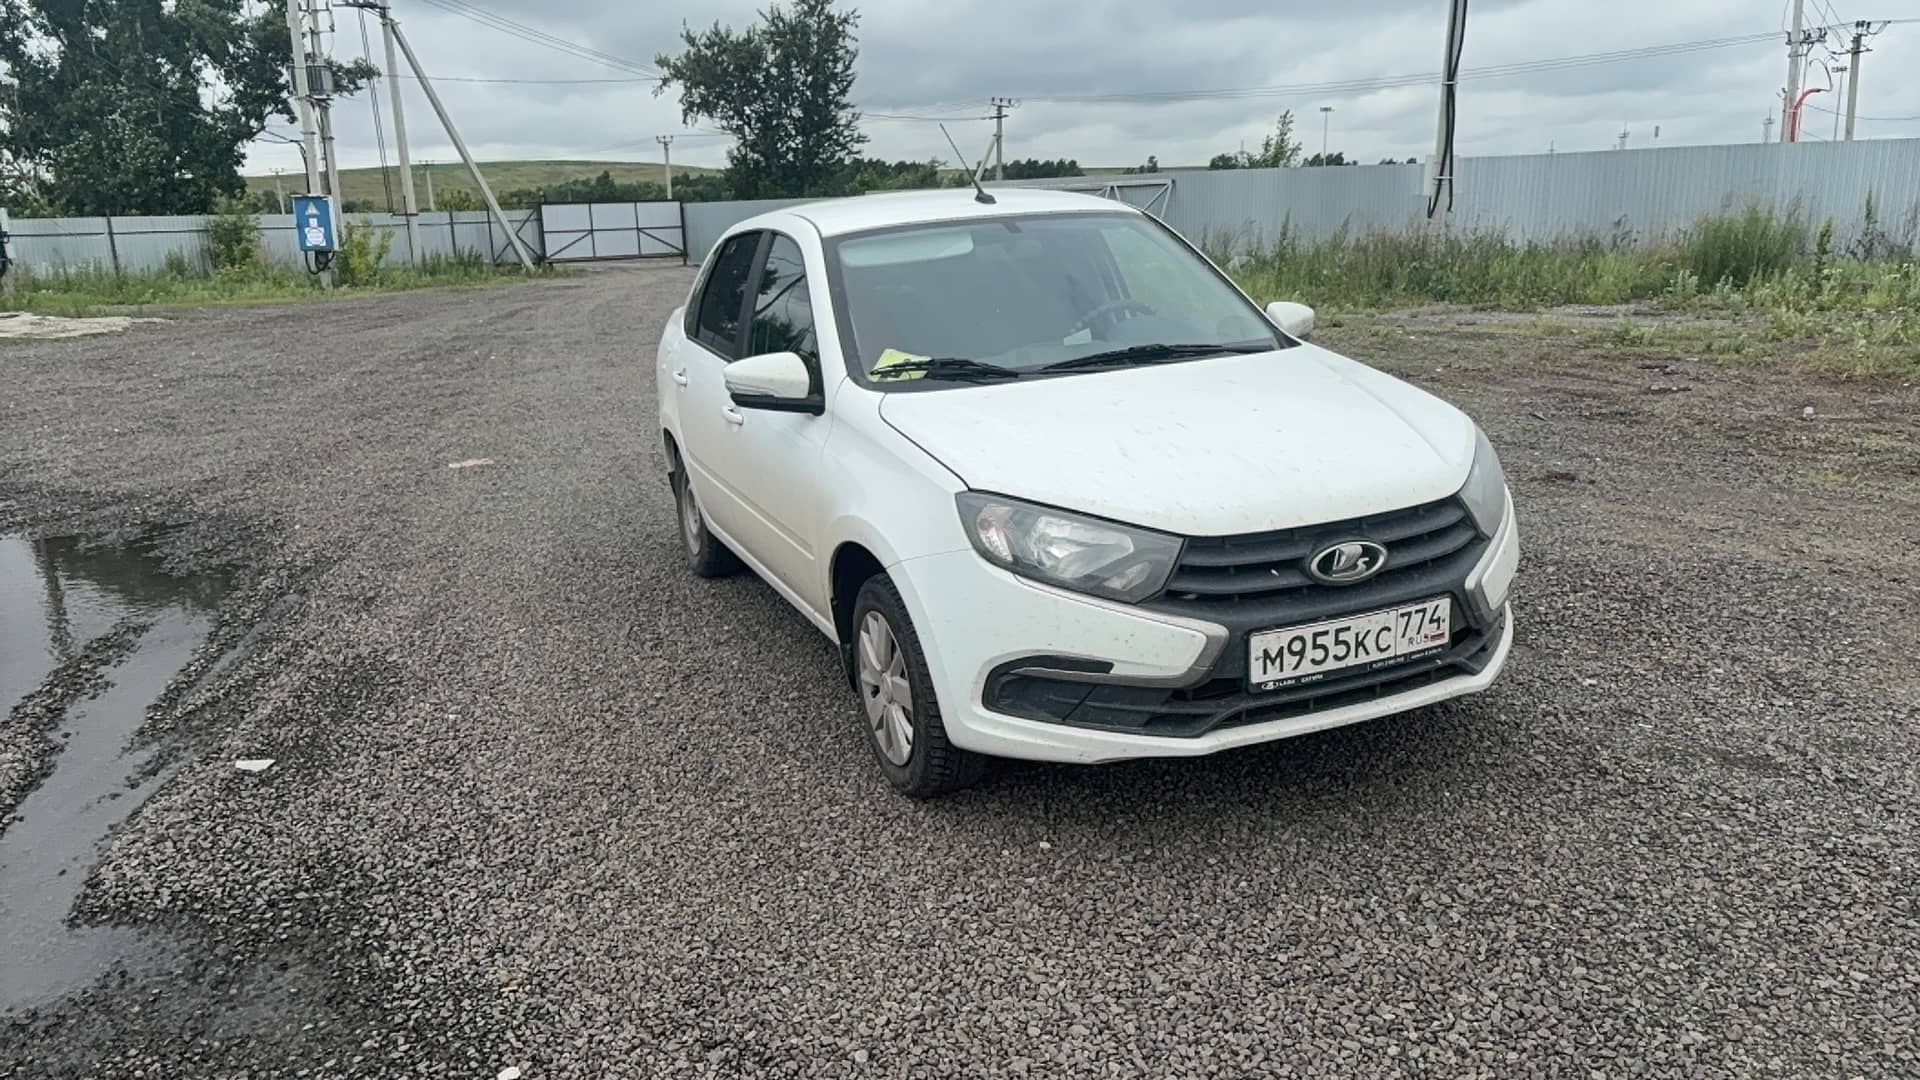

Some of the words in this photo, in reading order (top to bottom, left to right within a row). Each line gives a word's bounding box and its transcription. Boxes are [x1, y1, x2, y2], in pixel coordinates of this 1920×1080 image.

[1262, 626, 1391, 675] М955КС
[1399, 604, 1441, 639] 774
[1408, 633, 1429, 647] RUS
